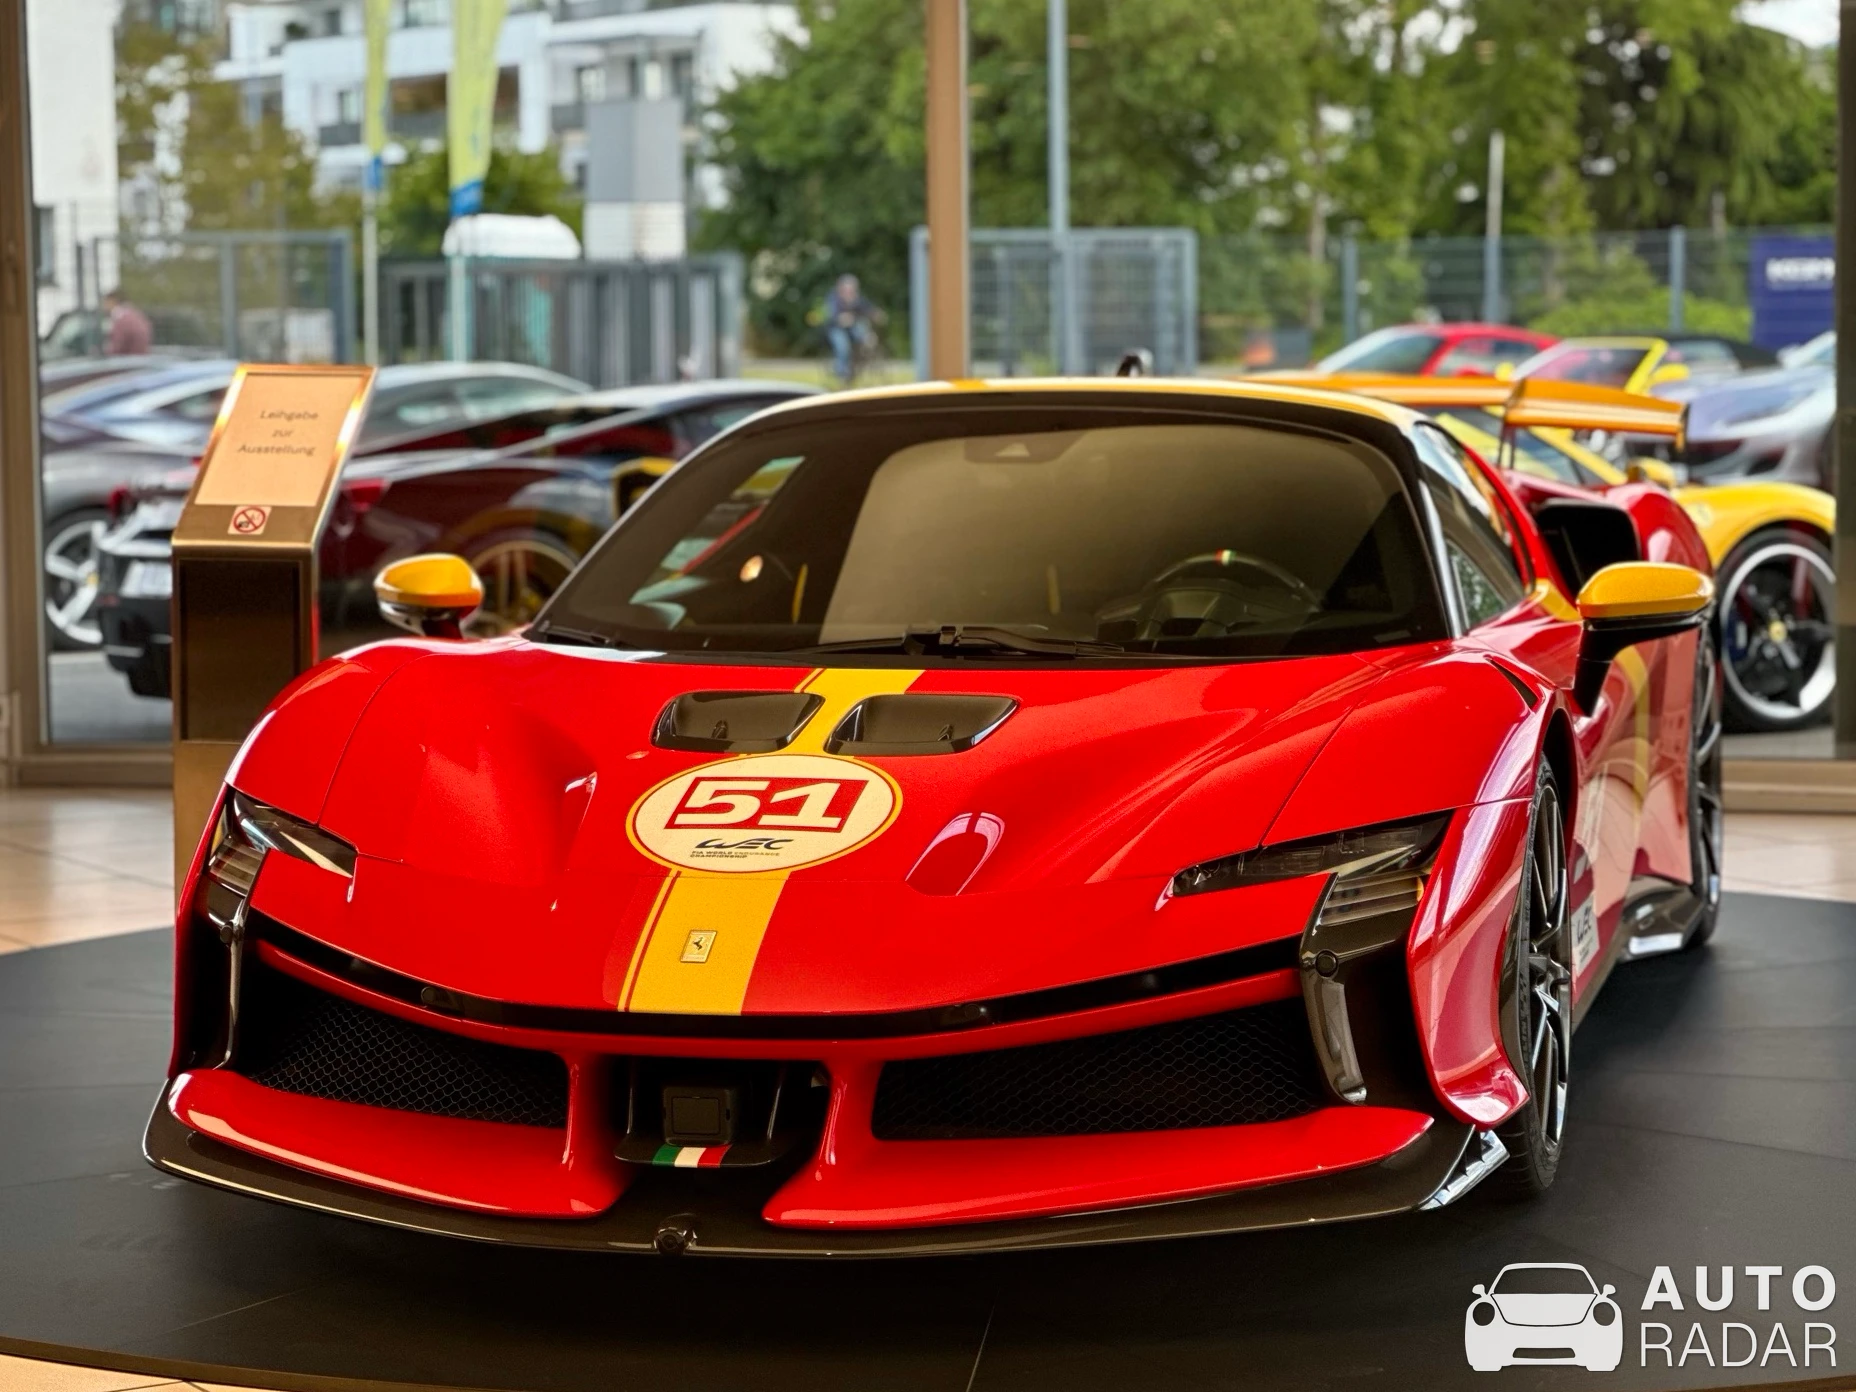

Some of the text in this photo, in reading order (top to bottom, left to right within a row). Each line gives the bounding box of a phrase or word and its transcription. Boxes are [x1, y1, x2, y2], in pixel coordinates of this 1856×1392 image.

[260, 410, 318, 421] Leihgabe
[272, 429, 293, 437] zur
[238, 444, 316, 456] Ausstellung
[674, 781, 842, 828] 51
[695, 838, 794, 850] WEC
